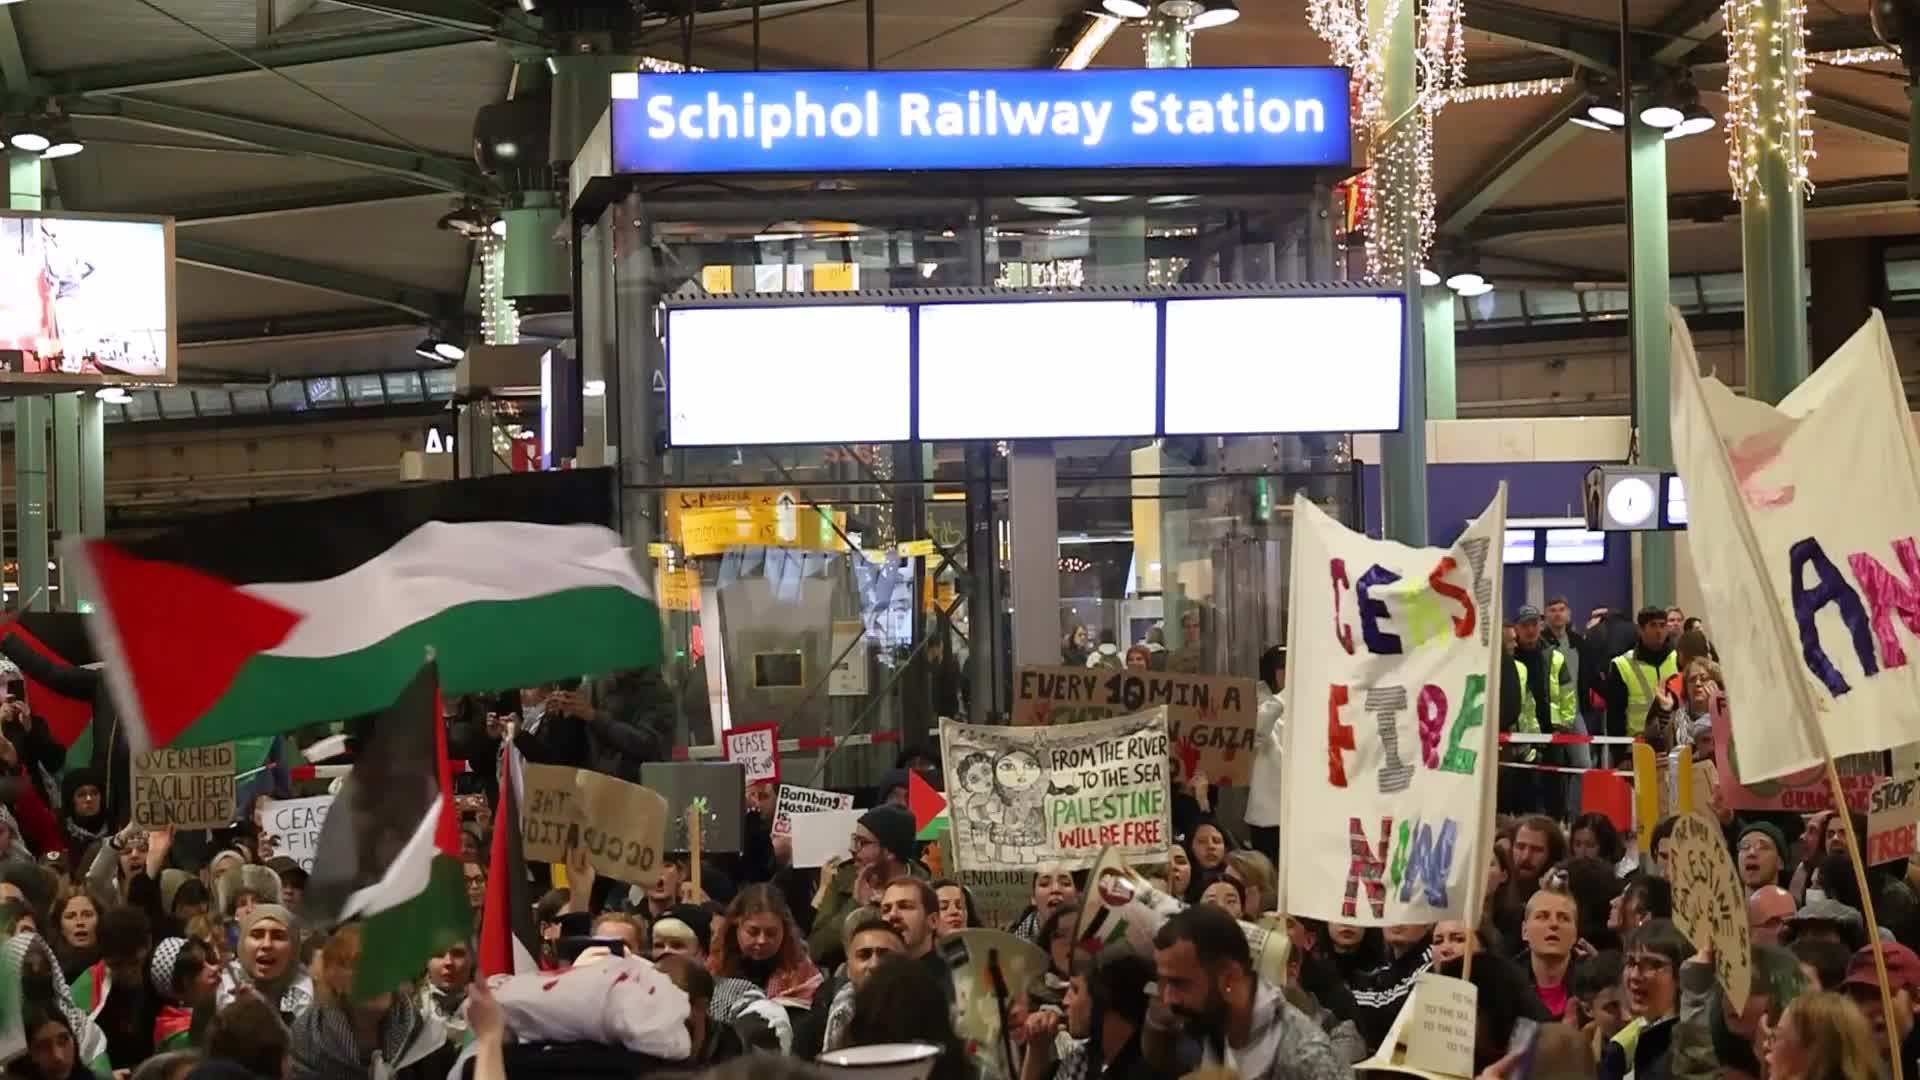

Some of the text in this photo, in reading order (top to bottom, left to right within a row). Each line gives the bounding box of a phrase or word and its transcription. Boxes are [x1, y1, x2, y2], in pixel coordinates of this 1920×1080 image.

[647, 87, 1326, 149] Schiphol Railway Station
[1019, 671, 1097, 700] EVERY
[1151, 678, 1208, 707] MIN
[1223, 687, 1241, 711] A
[732, 733, 767, 754] CEASE
[1192, 724, 1256, 750] GAZA
[1327, 673, 1487, 794] FIRE
[136, 748, 232, 769] OVERHEID
[1052, 735, 1168, 771] FROM THE RIVER
[135, 775, 235, 800] FACILITEERT
[1078, 771, 1098, 789] TO
[1101, 767, 1129, 787] THE
[1134, 763, 1161, 784] SEA
[780, 786, 840, 810] Bombing
[1053, 790, 1163, 826] PALESTINE
[136, 800, 230, 825] GENOCIDE
[1058, 820, 1161, 849] WILL BE FREE
